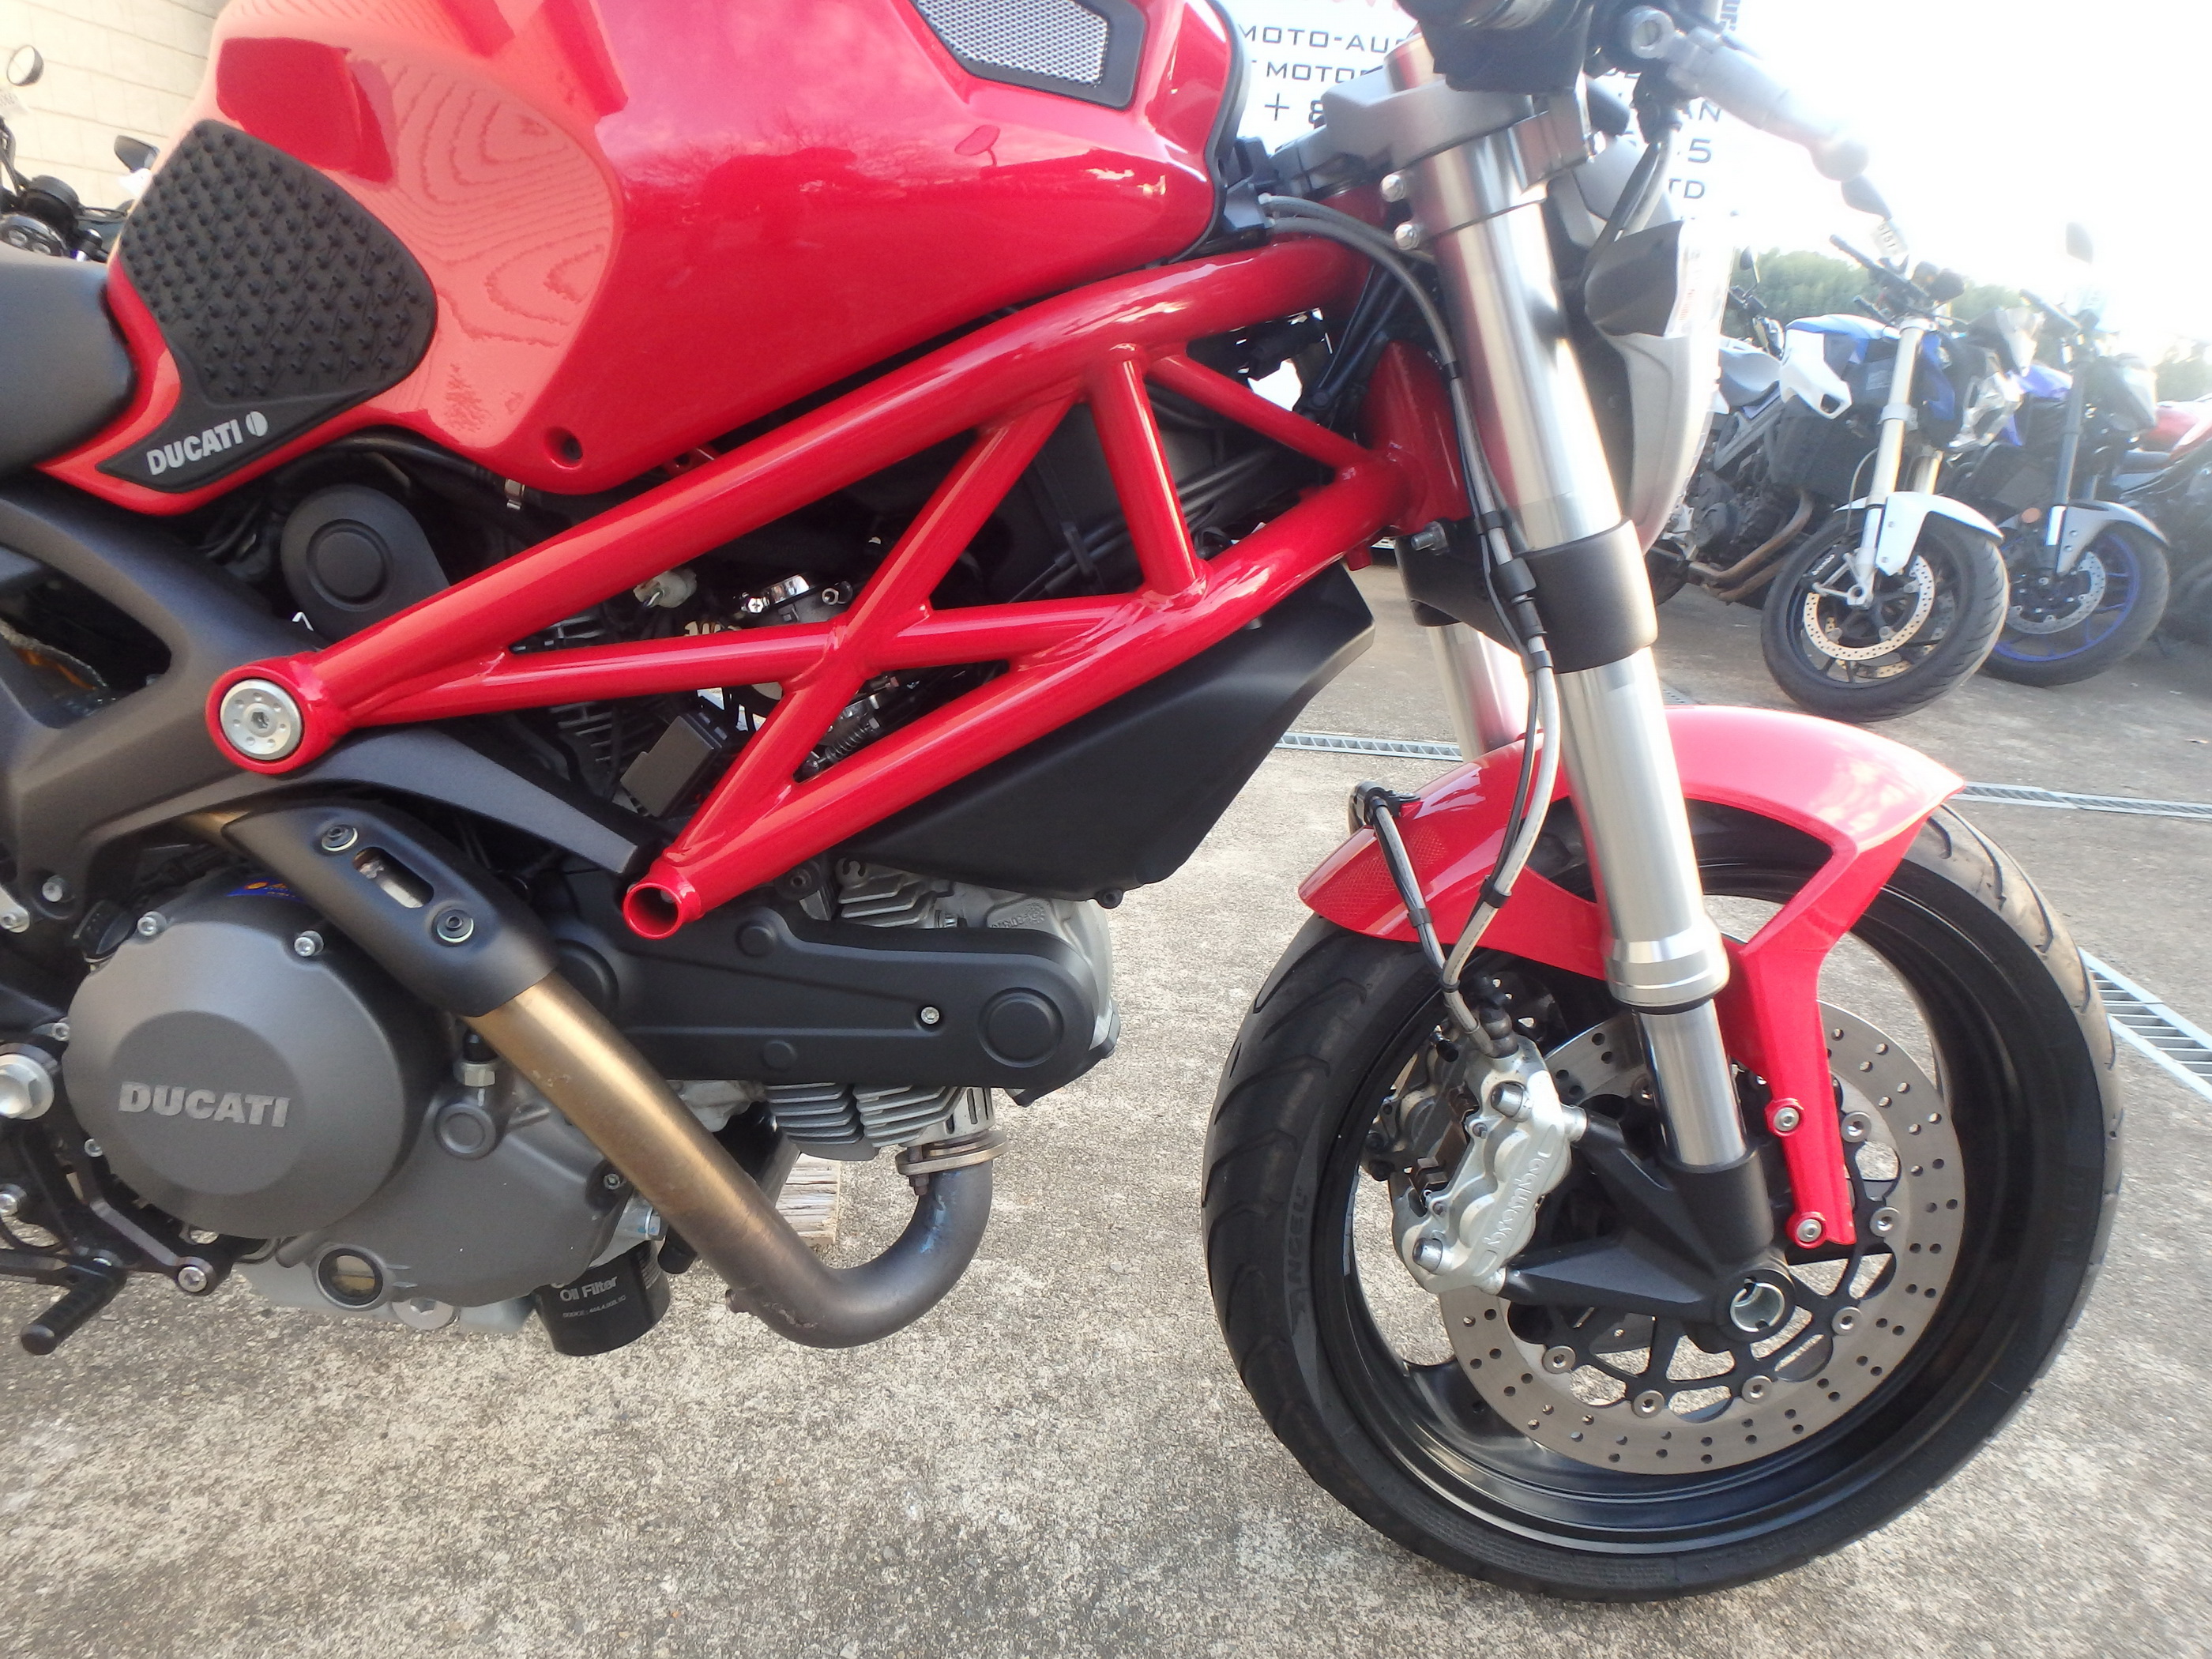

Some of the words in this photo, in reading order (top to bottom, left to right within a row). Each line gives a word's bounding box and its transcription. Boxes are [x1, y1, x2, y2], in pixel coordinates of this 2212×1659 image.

[1238, 24, 1404, 54] MOTO-AU
[1266, 62, 1369, 84] MOTO
[146, 419, 243, 476] DUCATI
[118, 1081, 291, 1127] DUCATI
[1483, 1157, 1546, 1248] brembo
[560, 1288, 580, 1302] Oil
[581, 1276, 618, 1298] Filter
